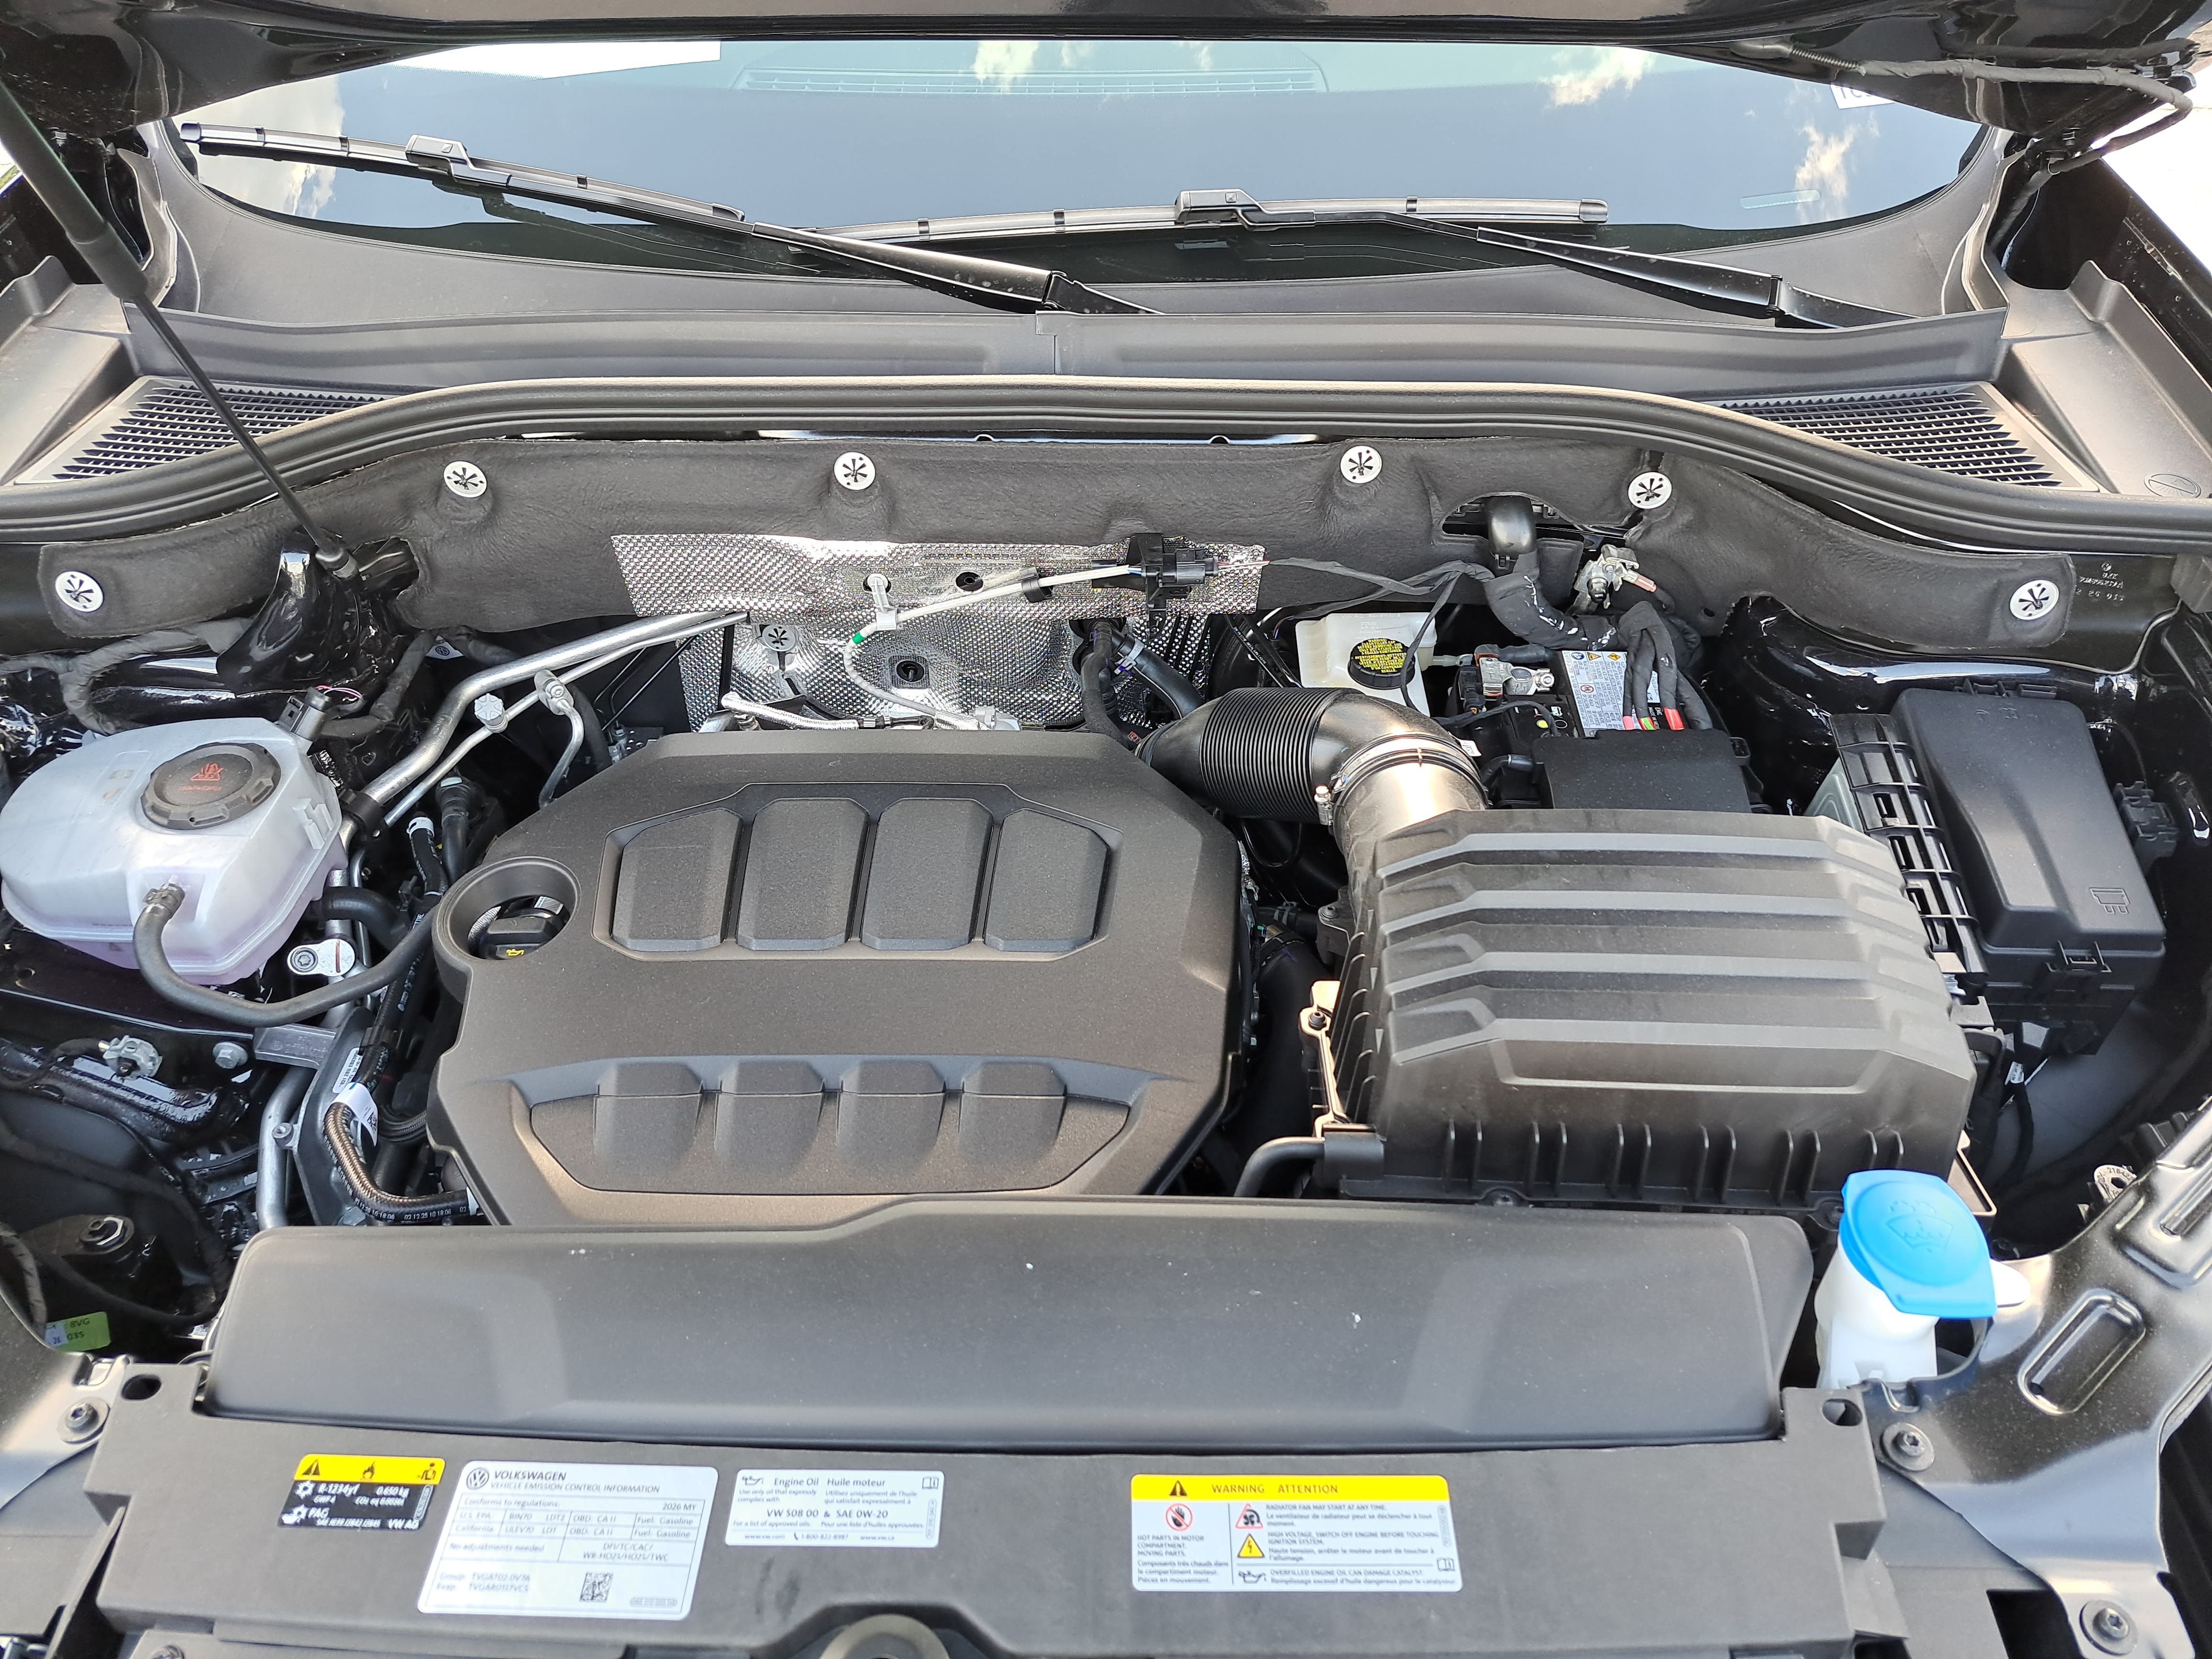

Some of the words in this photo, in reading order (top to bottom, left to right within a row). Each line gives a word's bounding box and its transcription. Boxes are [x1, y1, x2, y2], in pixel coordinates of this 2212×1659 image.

[493, 1470, 567, 1481] VOLKSWAGEN
[774, 1477, 804, 1487] Engine
[806, 1478, 819, 1486] Oil
[826, 1477, 851, 1486] Huile
[852, 1478, 885, 1486] moteur
[318, 1482, 360, 1496] R-1234yf
[489, 1481, 523, 1490] VEHICLE
[524, 1482, 563, 1491] EMISSION
[564, 1483, 602, 1492] CONTROL
[603, 1484, 661, 1493] INFORMATION
[1212, 1484, 1264, 1493] WARNING
[1278, 1484, 1338, 1493] ATTENTION
[662, 1502, 682, 1511] 2026
[682, 1503, 697, 1511] MY
[308, 1508, 330, 1517] PAG
[509, 1512, 533, 1520] BIN70
[545, 1513, 566, 1521] LDT2
[766, 1508, 784, 1517] VW
[786, 1509, 803, 1517] 508
[806, 1509, 819, 1517] 00
[836, 1509, 853, 1518] SAE
[856, 1510, 888, 1518] 0W-20
[388, 1519, 405, 1528] VW
[596, 1515, 609, 1523] CA
[659, 1516, 694, 1525] Gasoline
[504, 1525, 535, 1533] ULEV70
[593, 1527, 606, 1536] CA
[656, 1529, 691, 1537] Gasoline
[462, 1543, 513, 1553] adjustments
